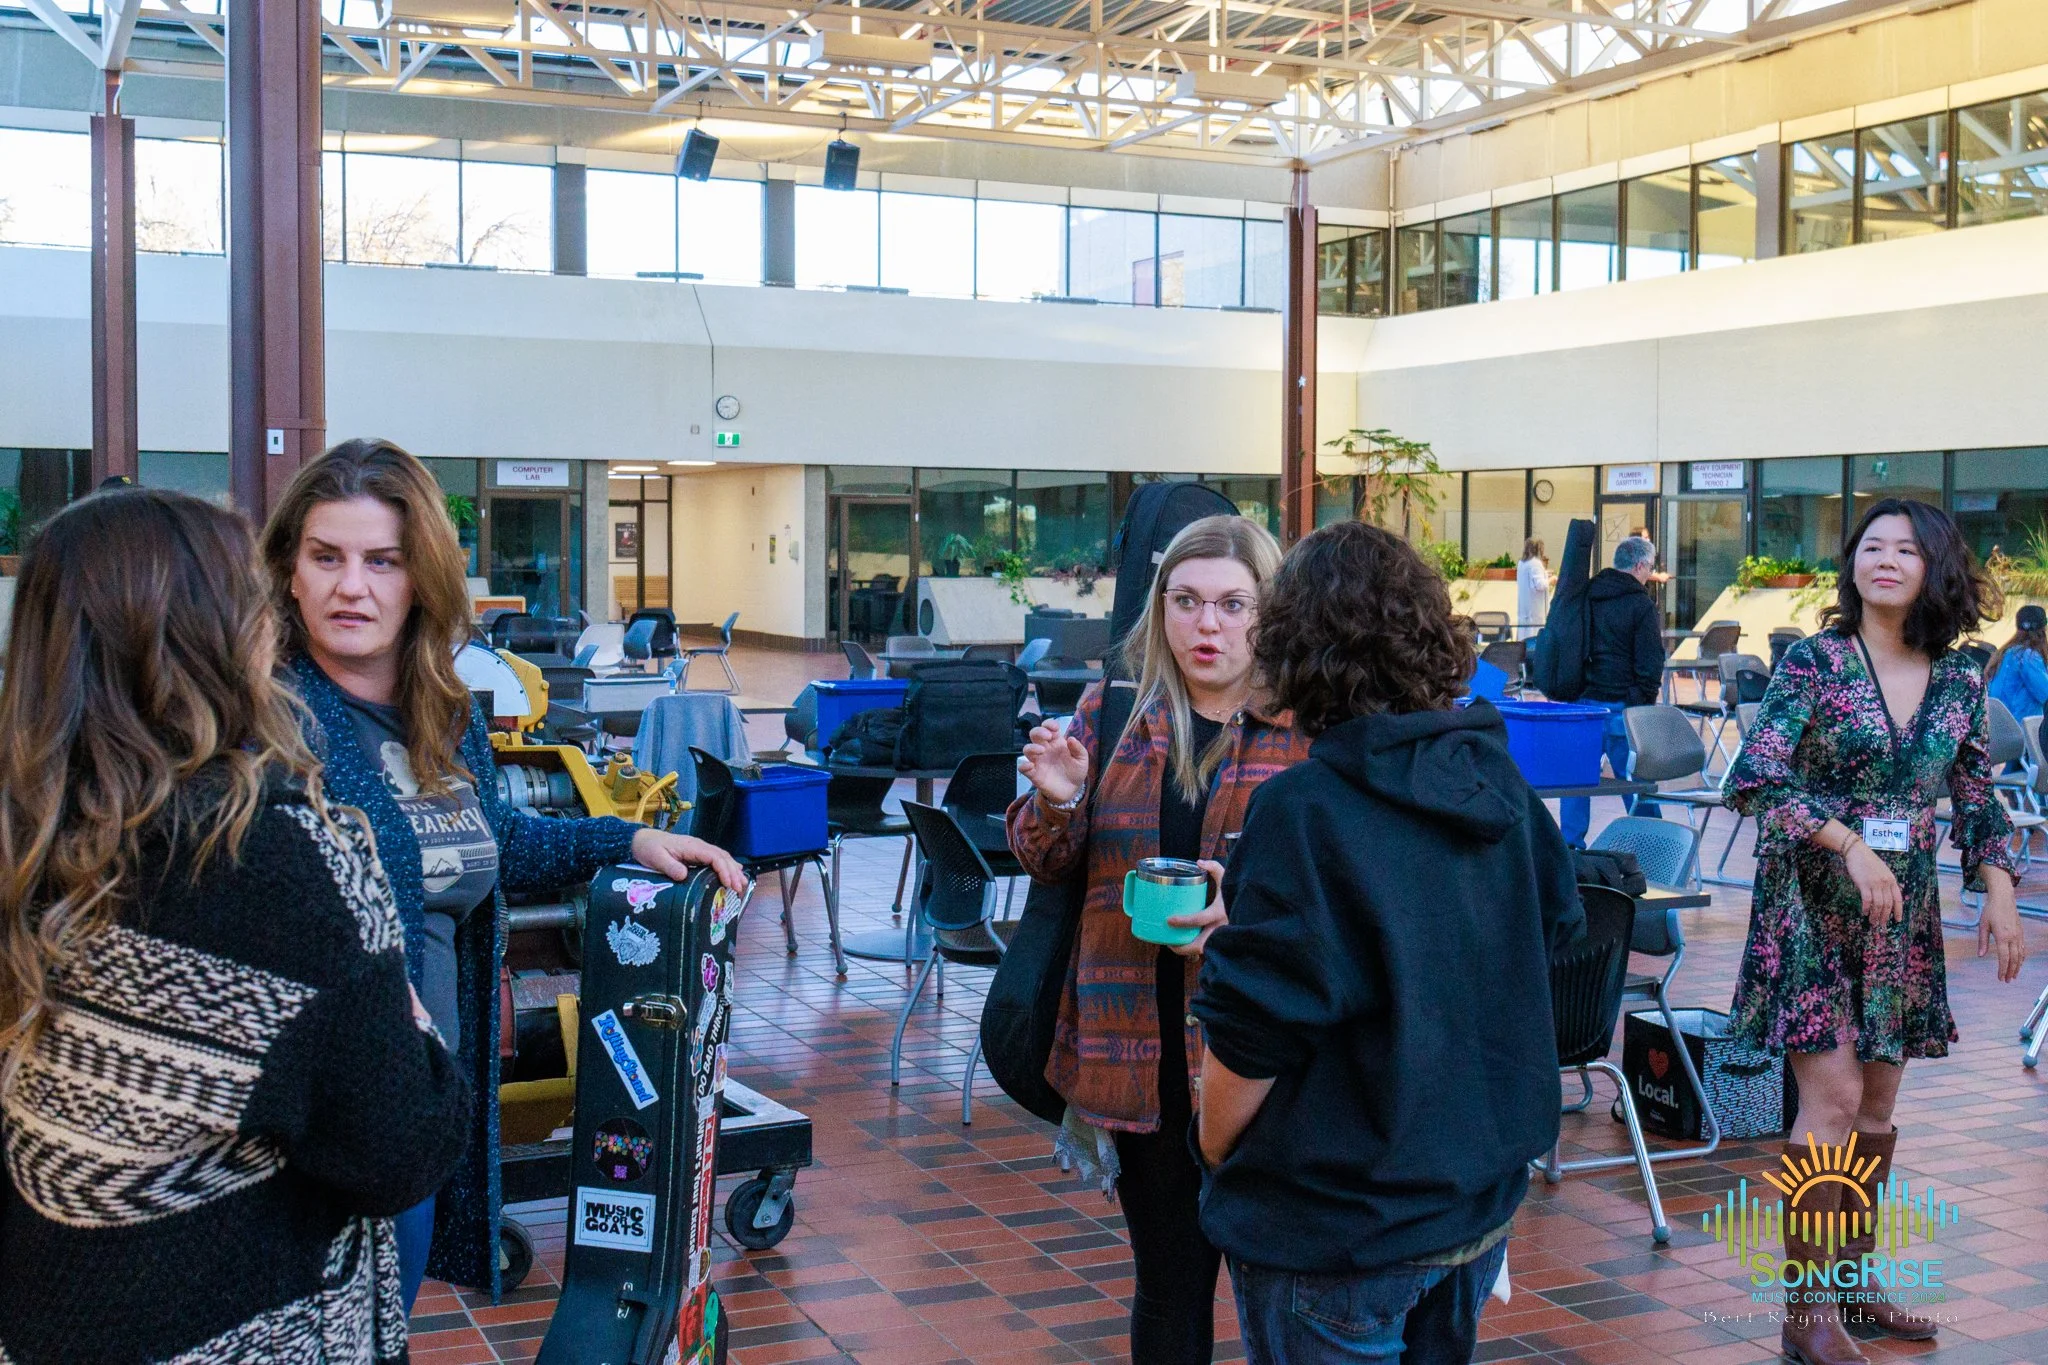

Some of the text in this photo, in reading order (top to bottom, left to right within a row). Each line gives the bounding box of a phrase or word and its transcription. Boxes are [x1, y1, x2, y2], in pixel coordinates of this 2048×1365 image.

[512, 466, 553, 474] COMPUTER
[1692, 463, 1741, 472] HEAVY EQUIPMENT
[1702, 472, 1733, 480] TECHNICIAN
[1705, 480, 1724, 488] PERIOD
[408, 807, 490, 838] EARNEY
[1872, 829, 1904, 838] Esther
[698, 1074, 707, 1096] DO
[703, 1044, 714, 1075] BAD
[694, 1119, 705, 1171] What's
[692, 1171, 702, 1205] Your
[586, 1202, 644, 1222] MUSIC
[605, 1214, 628, 1226] FOR
